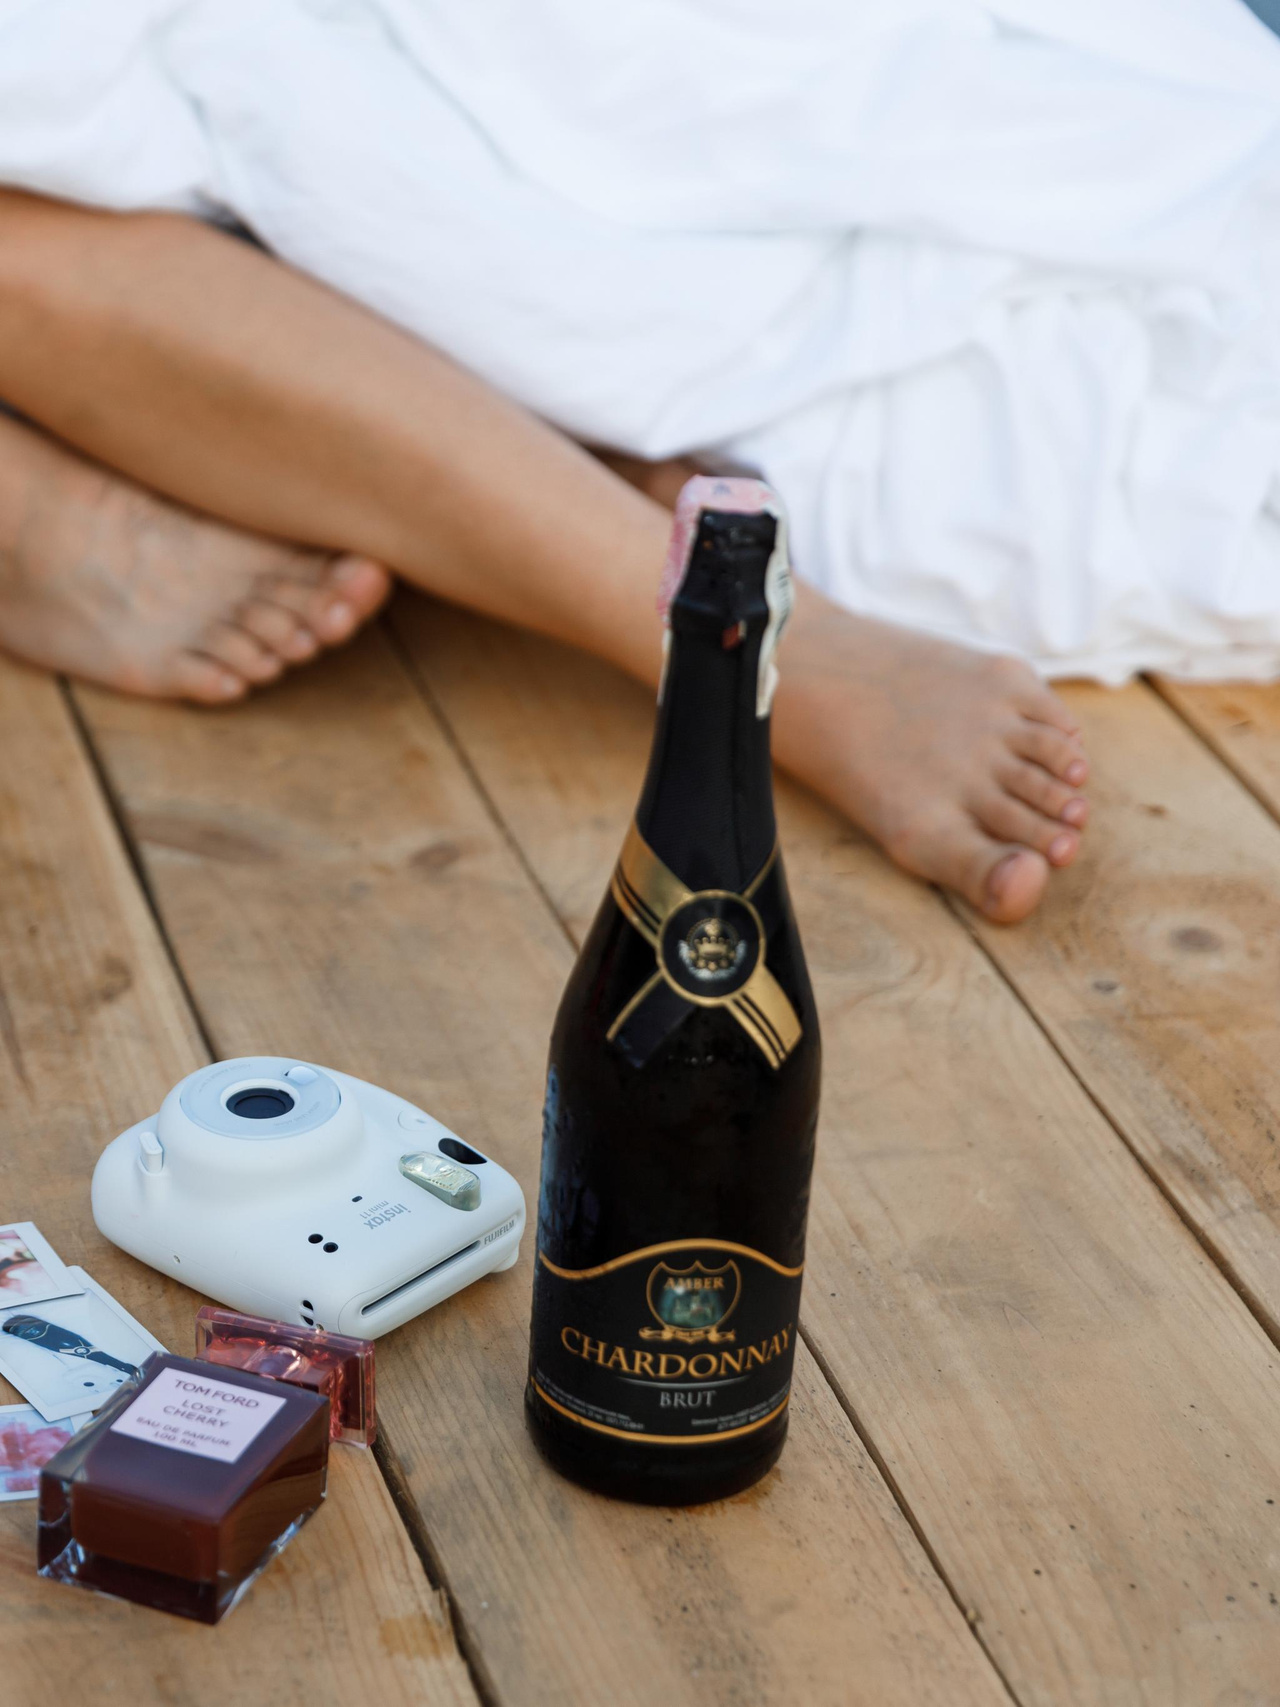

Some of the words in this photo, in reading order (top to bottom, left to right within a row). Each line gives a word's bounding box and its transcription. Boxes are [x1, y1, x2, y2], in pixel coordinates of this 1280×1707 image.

[363, 1204, 412, 1230] instax
[484, 1219, 515, 1245] FUJIFILM
[663, 1276, 725, 1291] AMBER
[561, 1324, 793, 1378] CHARDONNAY
[175, 1378, 211, 1396] TOM
[212, 1389, 260, 1409] FORD
[660, 1390, 716, 1408] BRUT
[163, 1405, 229, 1428] CHERRY
[182, 1399, 225, 1416] LOST
